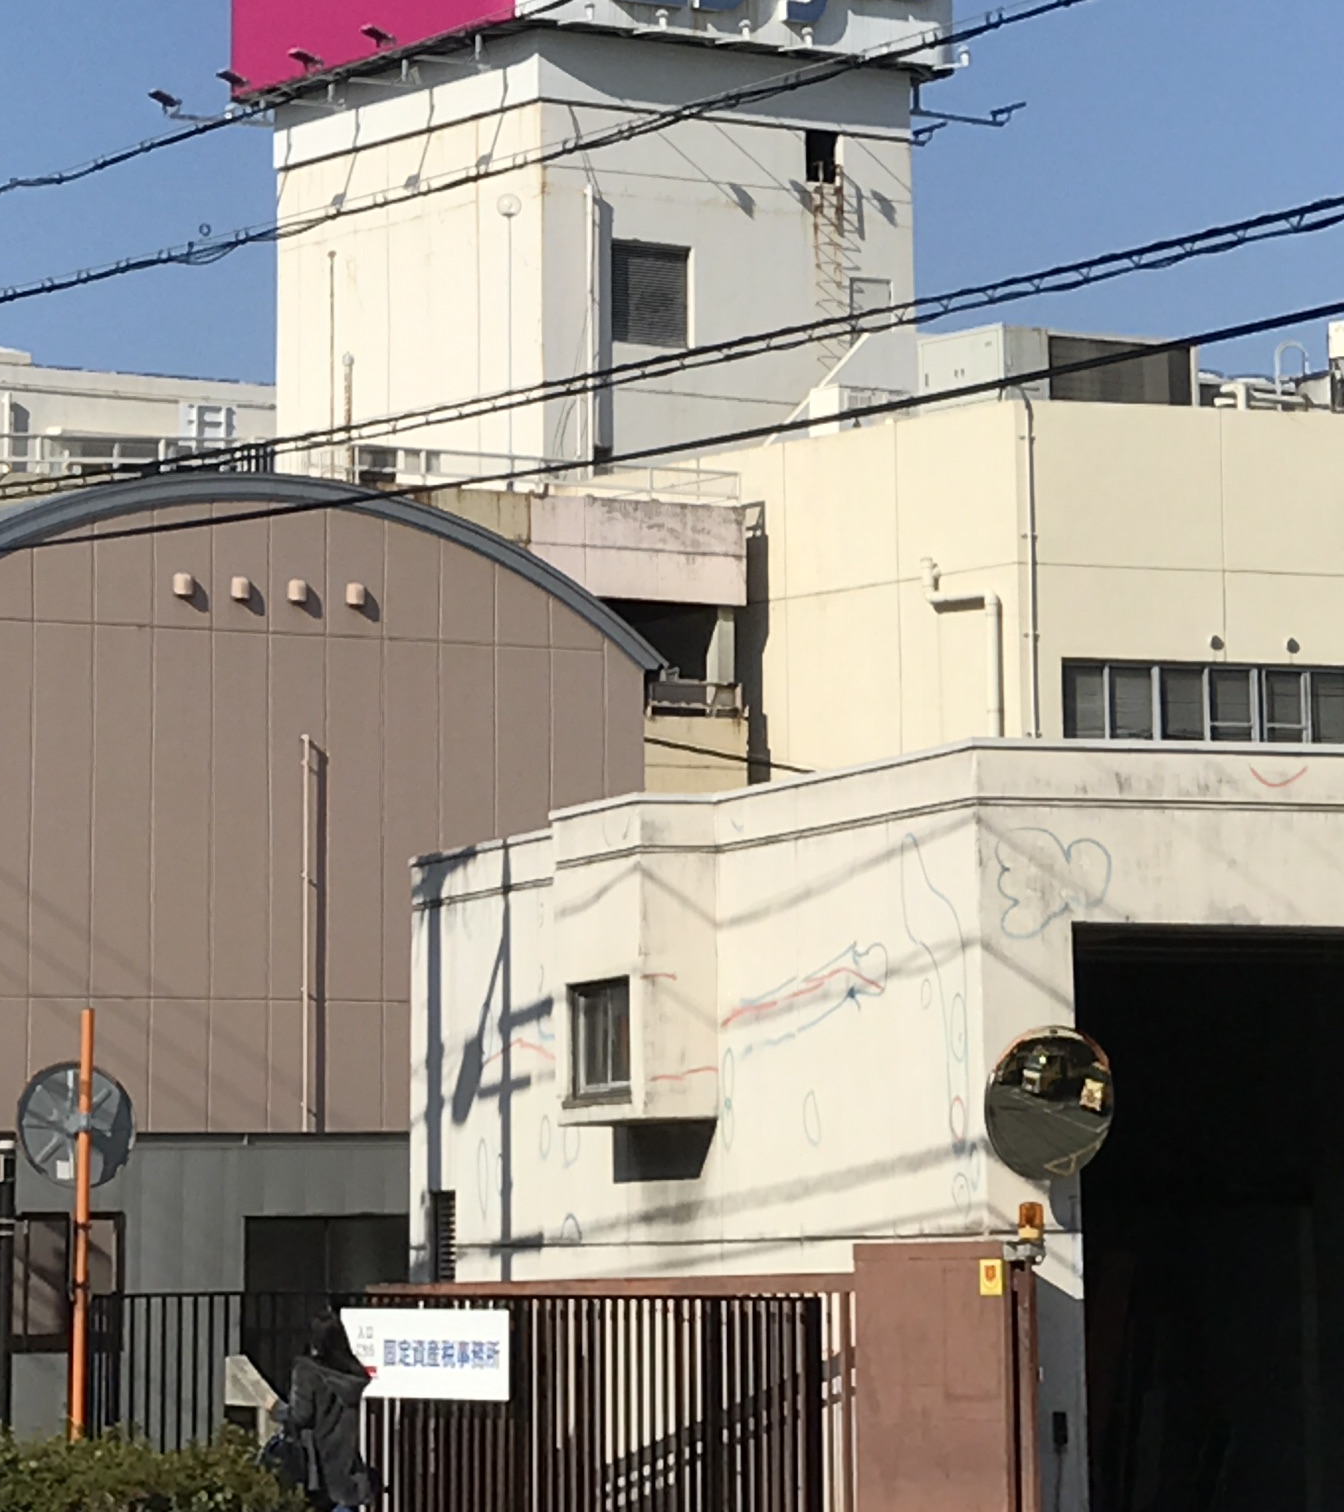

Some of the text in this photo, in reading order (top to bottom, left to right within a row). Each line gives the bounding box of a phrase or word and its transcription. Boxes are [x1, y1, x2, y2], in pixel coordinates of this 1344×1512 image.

[383, 1339, 500, 1370] 固定資産税事務所
